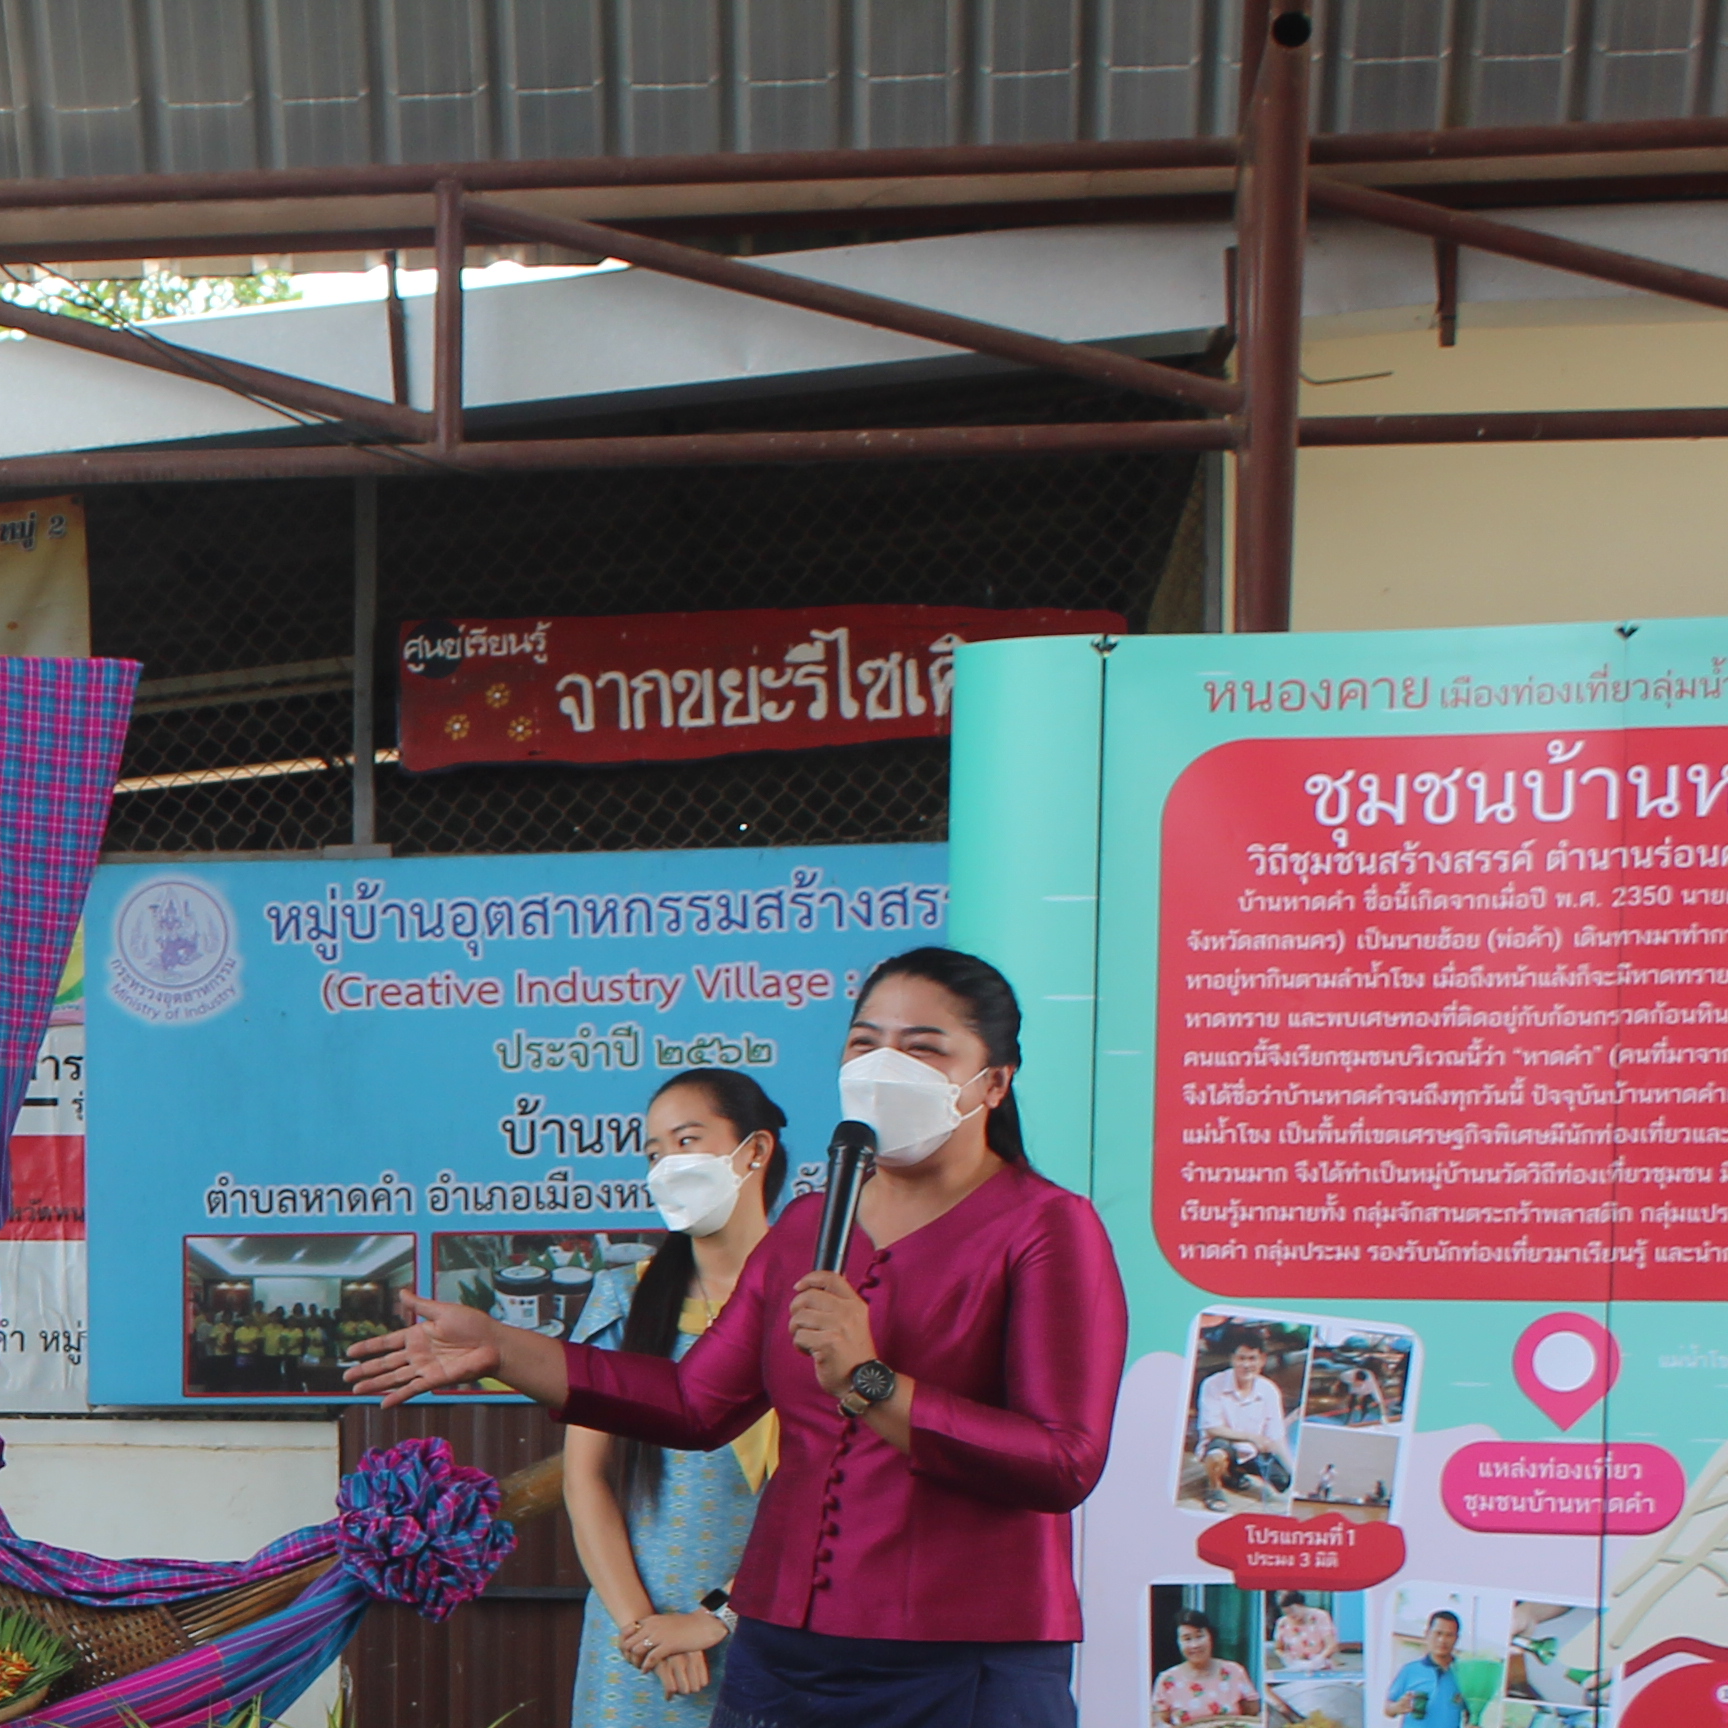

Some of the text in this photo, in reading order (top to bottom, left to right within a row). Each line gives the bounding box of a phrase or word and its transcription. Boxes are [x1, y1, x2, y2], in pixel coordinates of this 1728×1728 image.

[0, 511, 37, 550] หมู่
[48, 514, 66, 540] 2
[1203, 672, 1432, 714] หนองคาย
[1247, 839, 1536, 885] วิถีชุมชนสร้างสรรค์
[1238, 888, 1356, 913] บ้านหาดคำ
[1554, 889, 1602, 909] พ.ศ.
[1610, 884, 1673, 908] 2350
[1680, 888, 1728, 906] นาย
[265, 870, 948, 960] หมู่บ้านอุตสาหกรรมสร้างสร
[322, 973, 501, 1012] (Creative
[516, 970, 681, 1009] Industry
[695, 964, 831, 1005] Village
[164, 1006, 180, 1021] of
[1185, 1012, 1280, 1028] หาดทราย
[496, 1026, 639, 1072] ประจำปี
[30, 1055, 84, 1081] าร
[1531, 1081, 1728, 1112] ปัจจุบันบ้านหาดคำ
[1182, 1116, 1271, 1144] แม่น้ำโขง
[1181, 1162, 1288, 1183] จำนวนมาก
[206, 1171, 413, 1217] ตำบลหาดคำ
[1180, 1193, 1346, 1228] เรียนรู้มากมายทั้ง
[1179, 1239, 1247, 1259] หาดคำ
[1255, 1240, 1360, 1266] กลุ่มประมง
[1478, 1452, 1642, 1480] แหล่งท่องเที่ยว
[1463, 1488, 1656, 1517] ชุมชนบ้านหาดคำ
[1245, 1523, 1356, 1546] โปรแกรมที่ 1
[1299, 1553, 1311, 1567] 3
